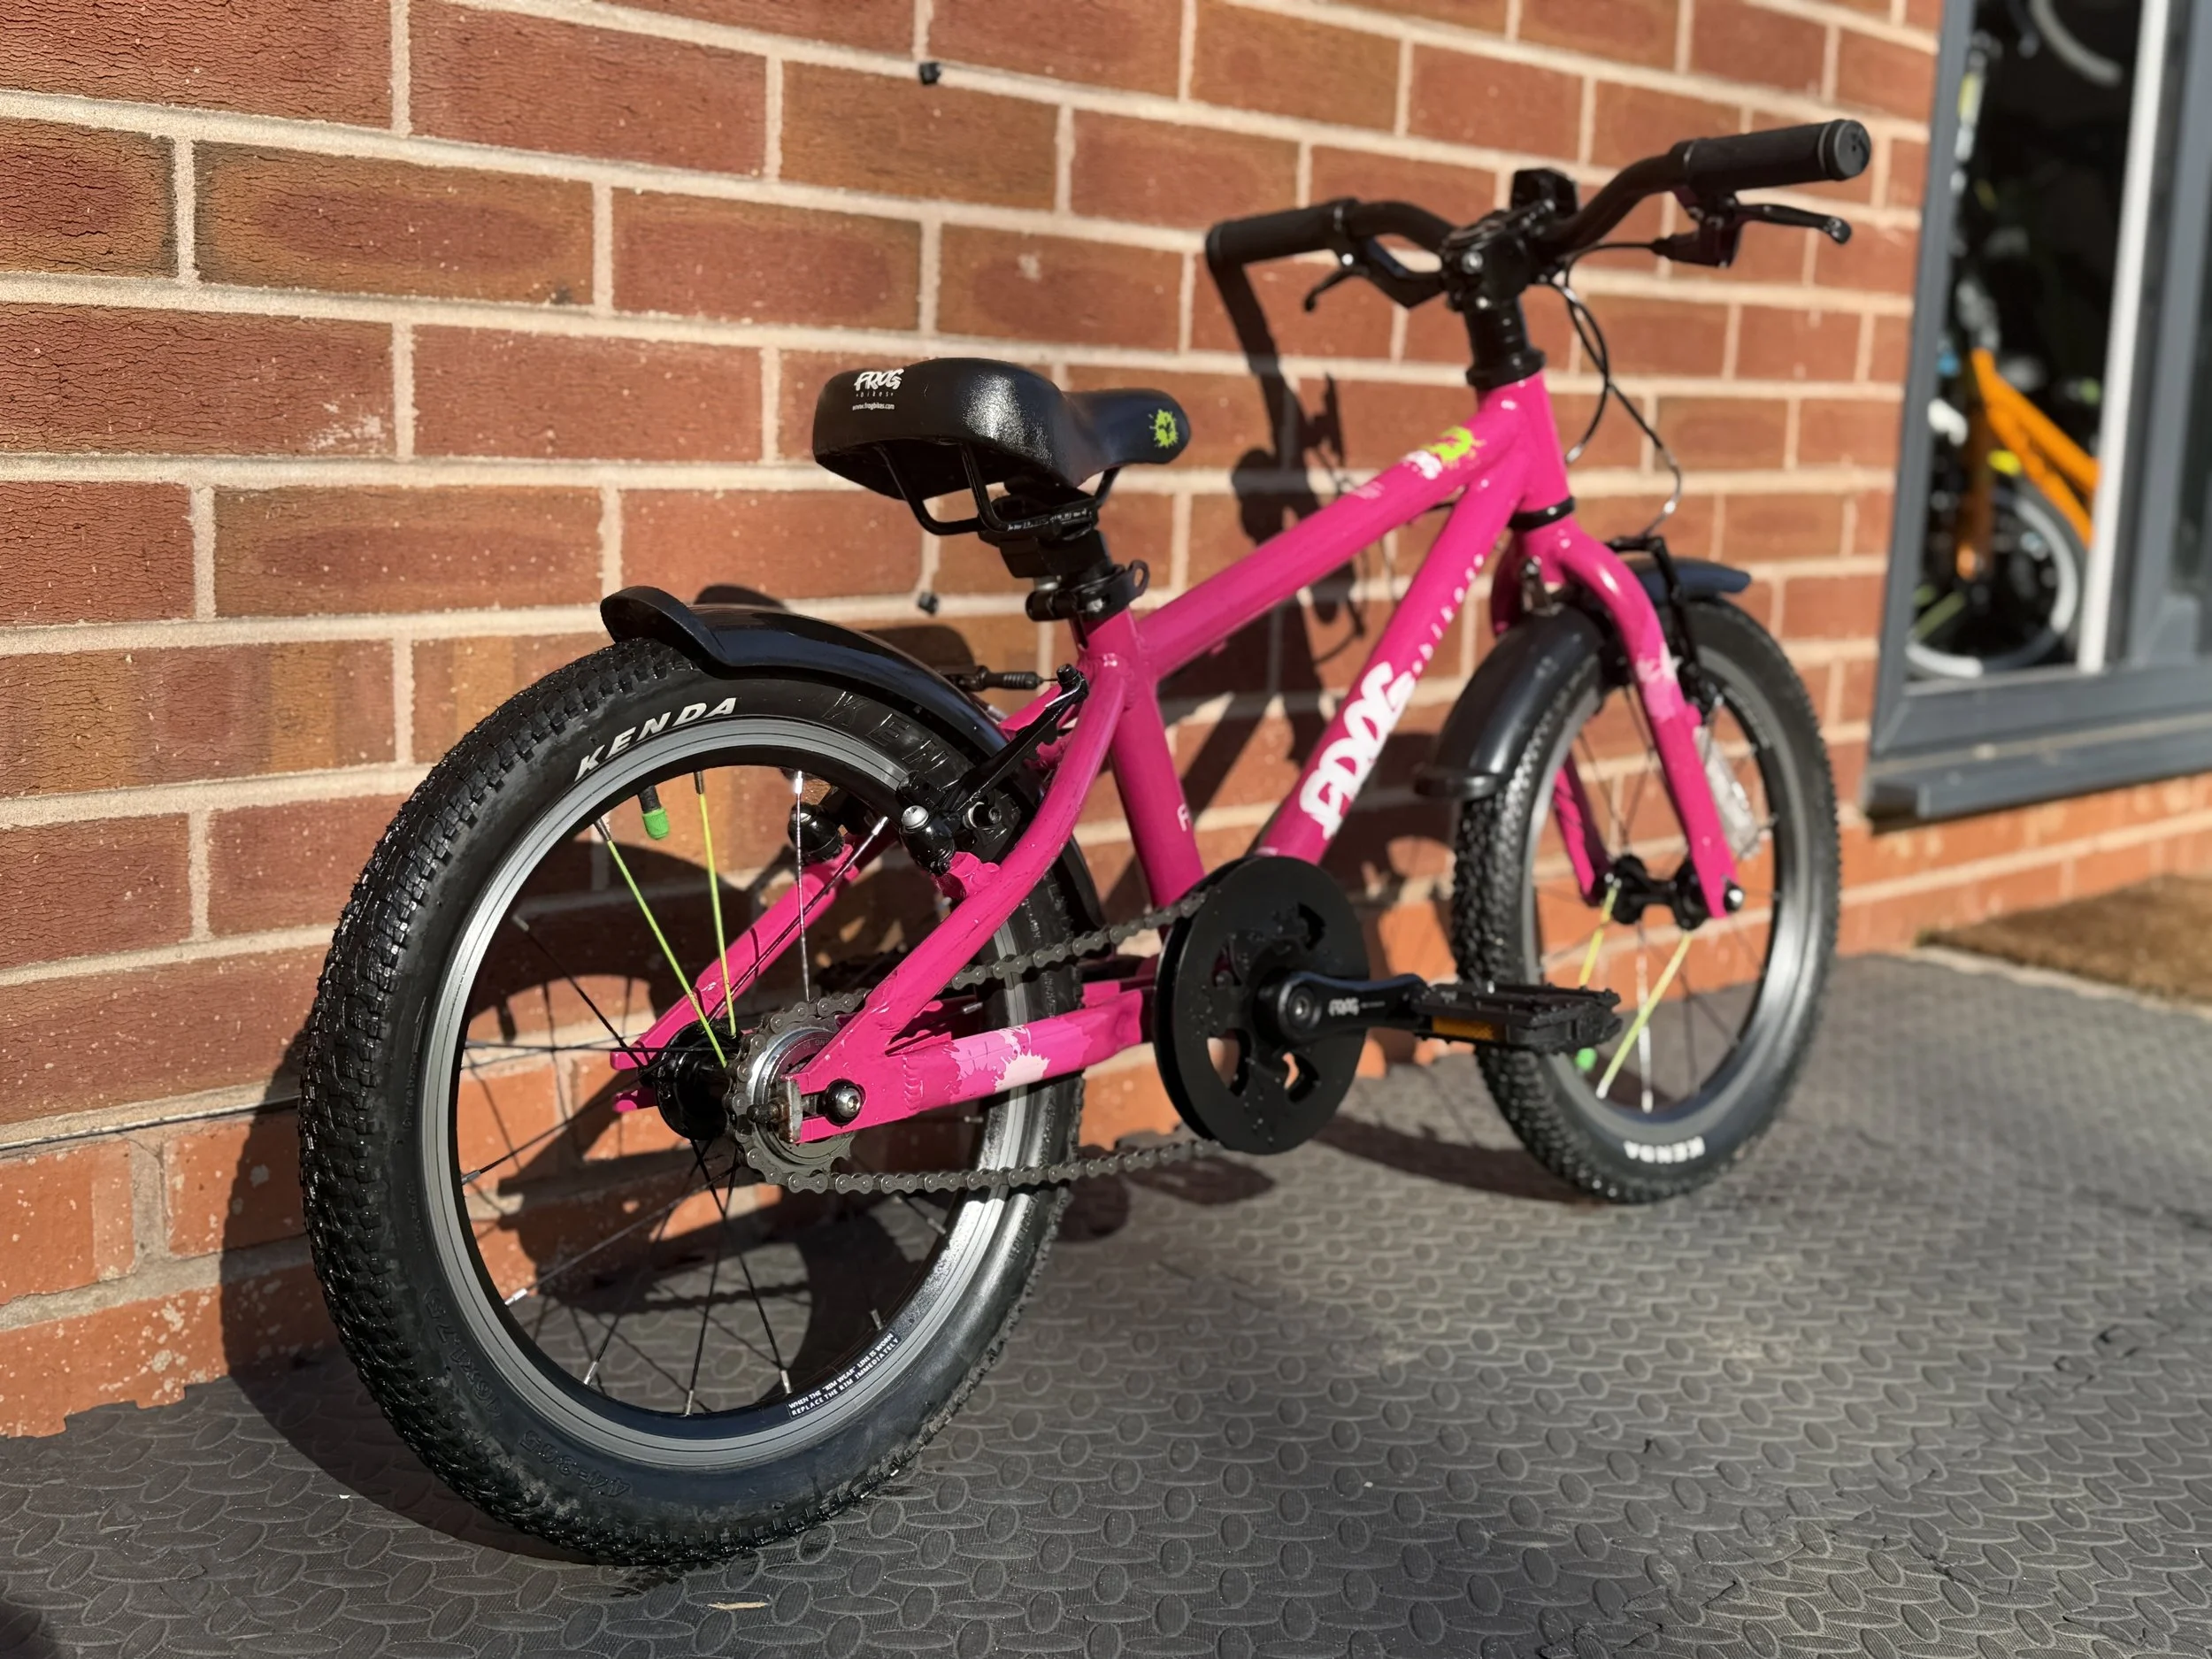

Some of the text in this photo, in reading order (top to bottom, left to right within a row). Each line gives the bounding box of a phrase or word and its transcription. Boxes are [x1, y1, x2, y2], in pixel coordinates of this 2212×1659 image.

[854, 369, 904, 391] FROG
[574, 697, 737, 782] KENDA
[1301, 662, 1416, 840] FROG
[1623, 1135, 1706, 1164] KENDA
[788, 1396, 809, 1409] WHEN
[809, 1390, 822, 1400] THE
[856, 1356, 871, 1368] LINE
[875, 1333, 894, 1351] WORN
[792, 1338, 899, 1416] REPLACE THE RIM IMMEDIATELY
